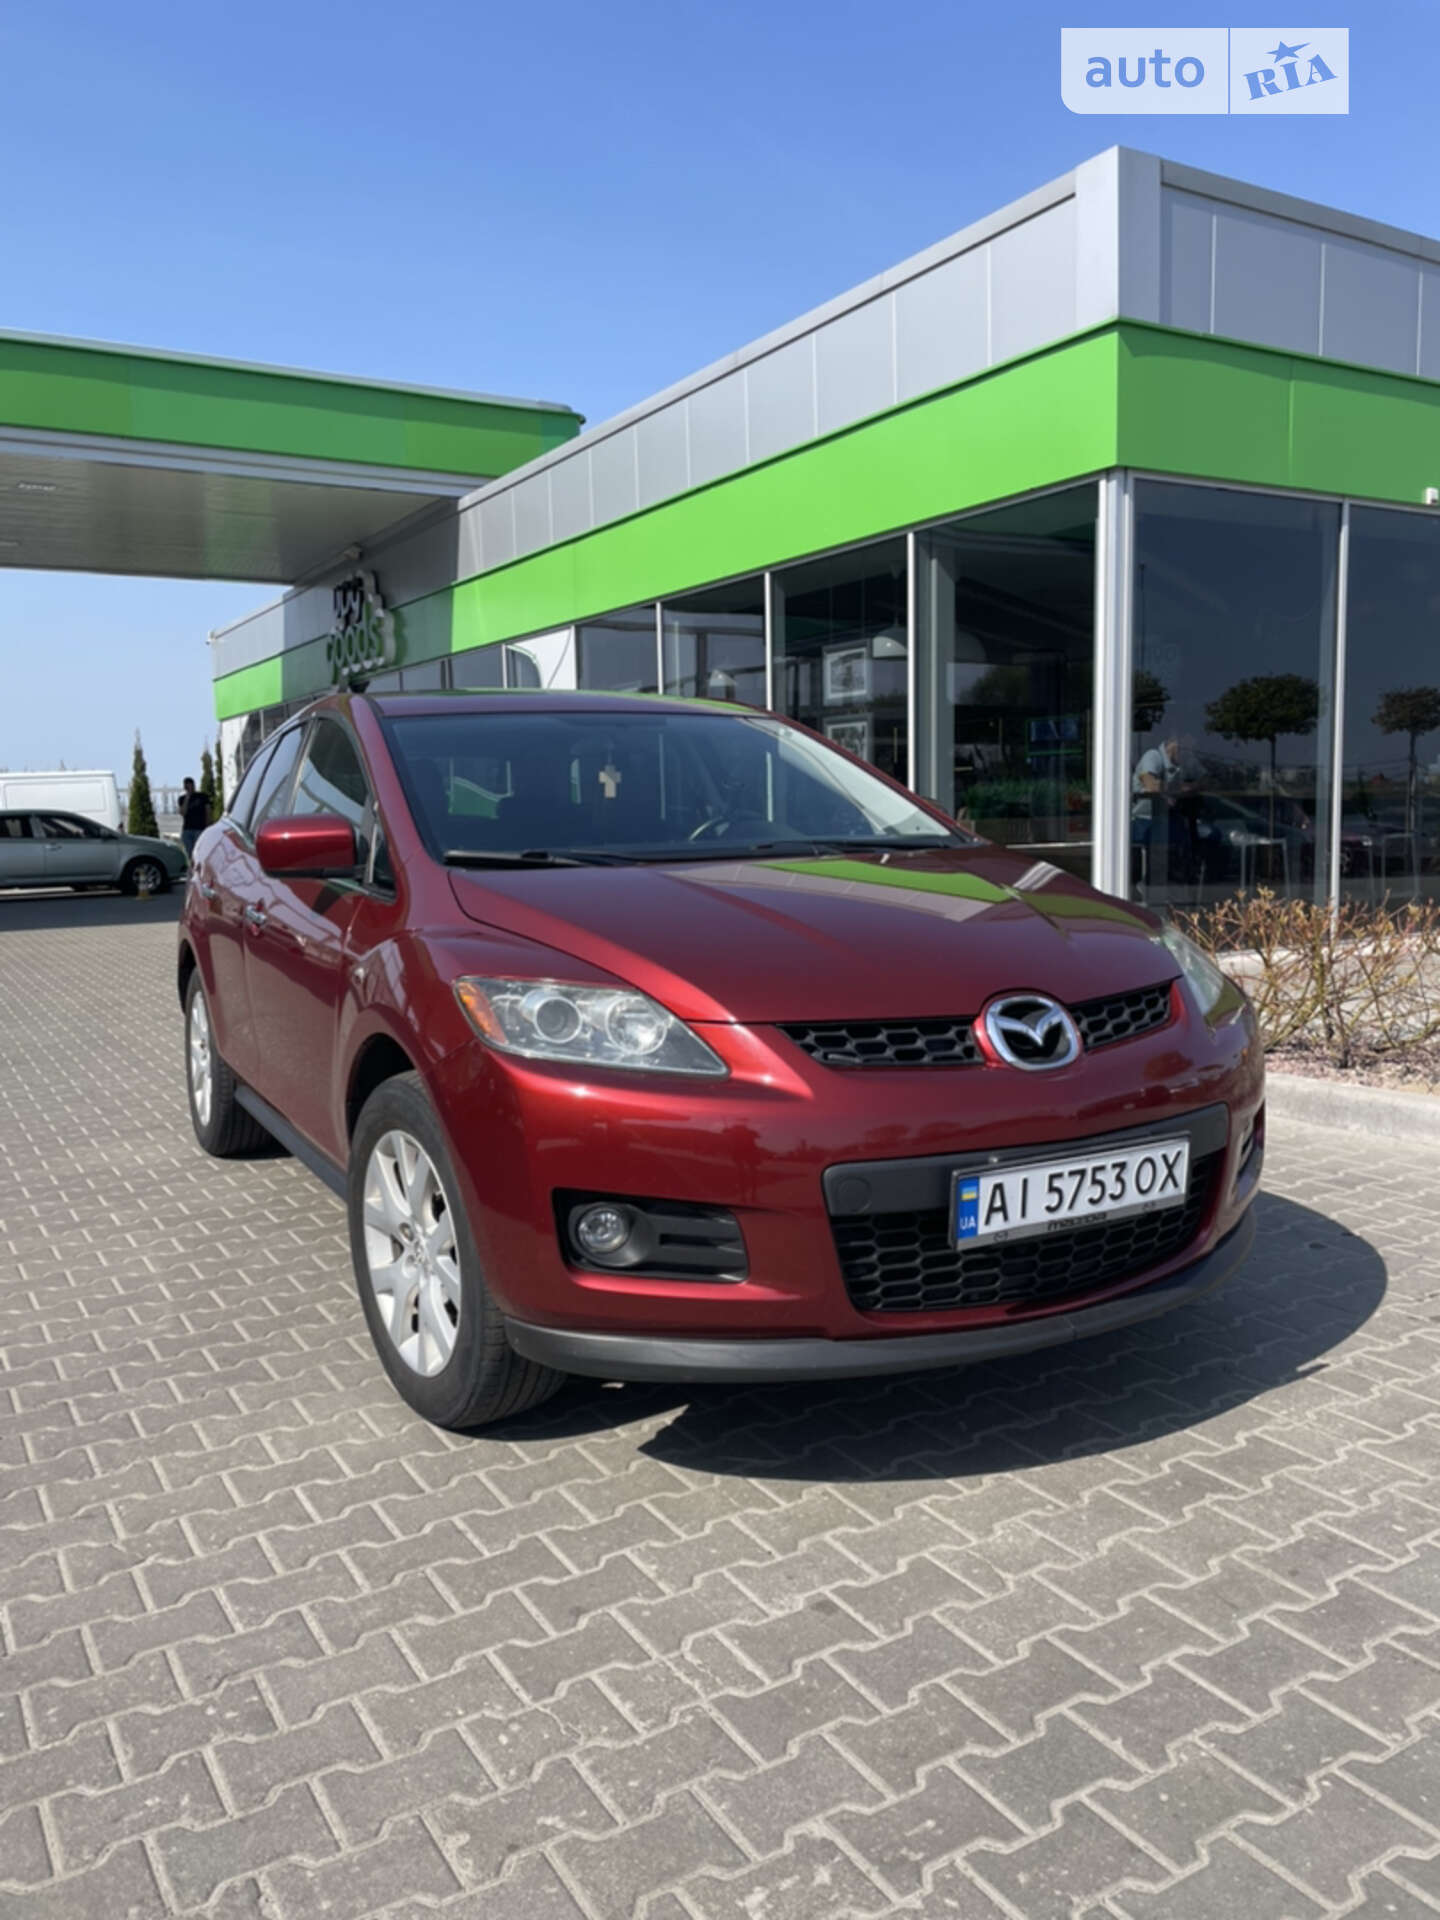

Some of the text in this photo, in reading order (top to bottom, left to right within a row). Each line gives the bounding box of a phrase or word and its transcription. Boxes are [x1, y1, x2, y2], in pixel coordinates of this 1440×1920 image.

[984, 1150, 1182, 1227] AI 5753 OX
[959, 1215, 977, 1231] UA
